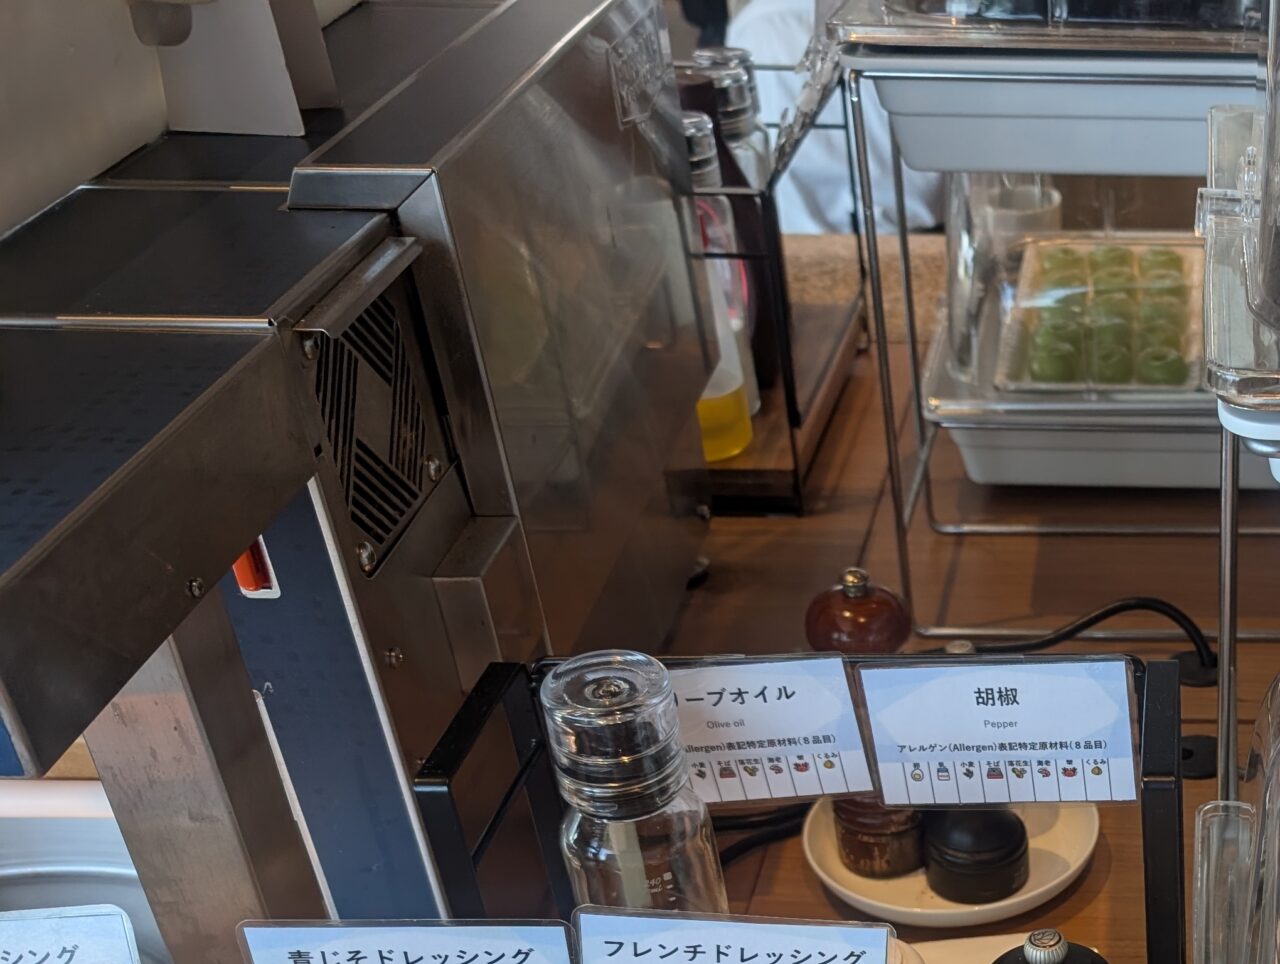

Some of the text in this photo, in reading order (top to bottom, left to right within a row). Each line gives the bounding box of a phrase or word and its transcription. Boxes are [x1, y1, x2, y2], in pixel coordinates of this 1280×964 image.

[974, 687, 1019, 706] 胡椒
[707, 720, 745, 729] Olive oil
[984, 720, 1018, 730] Pepper
